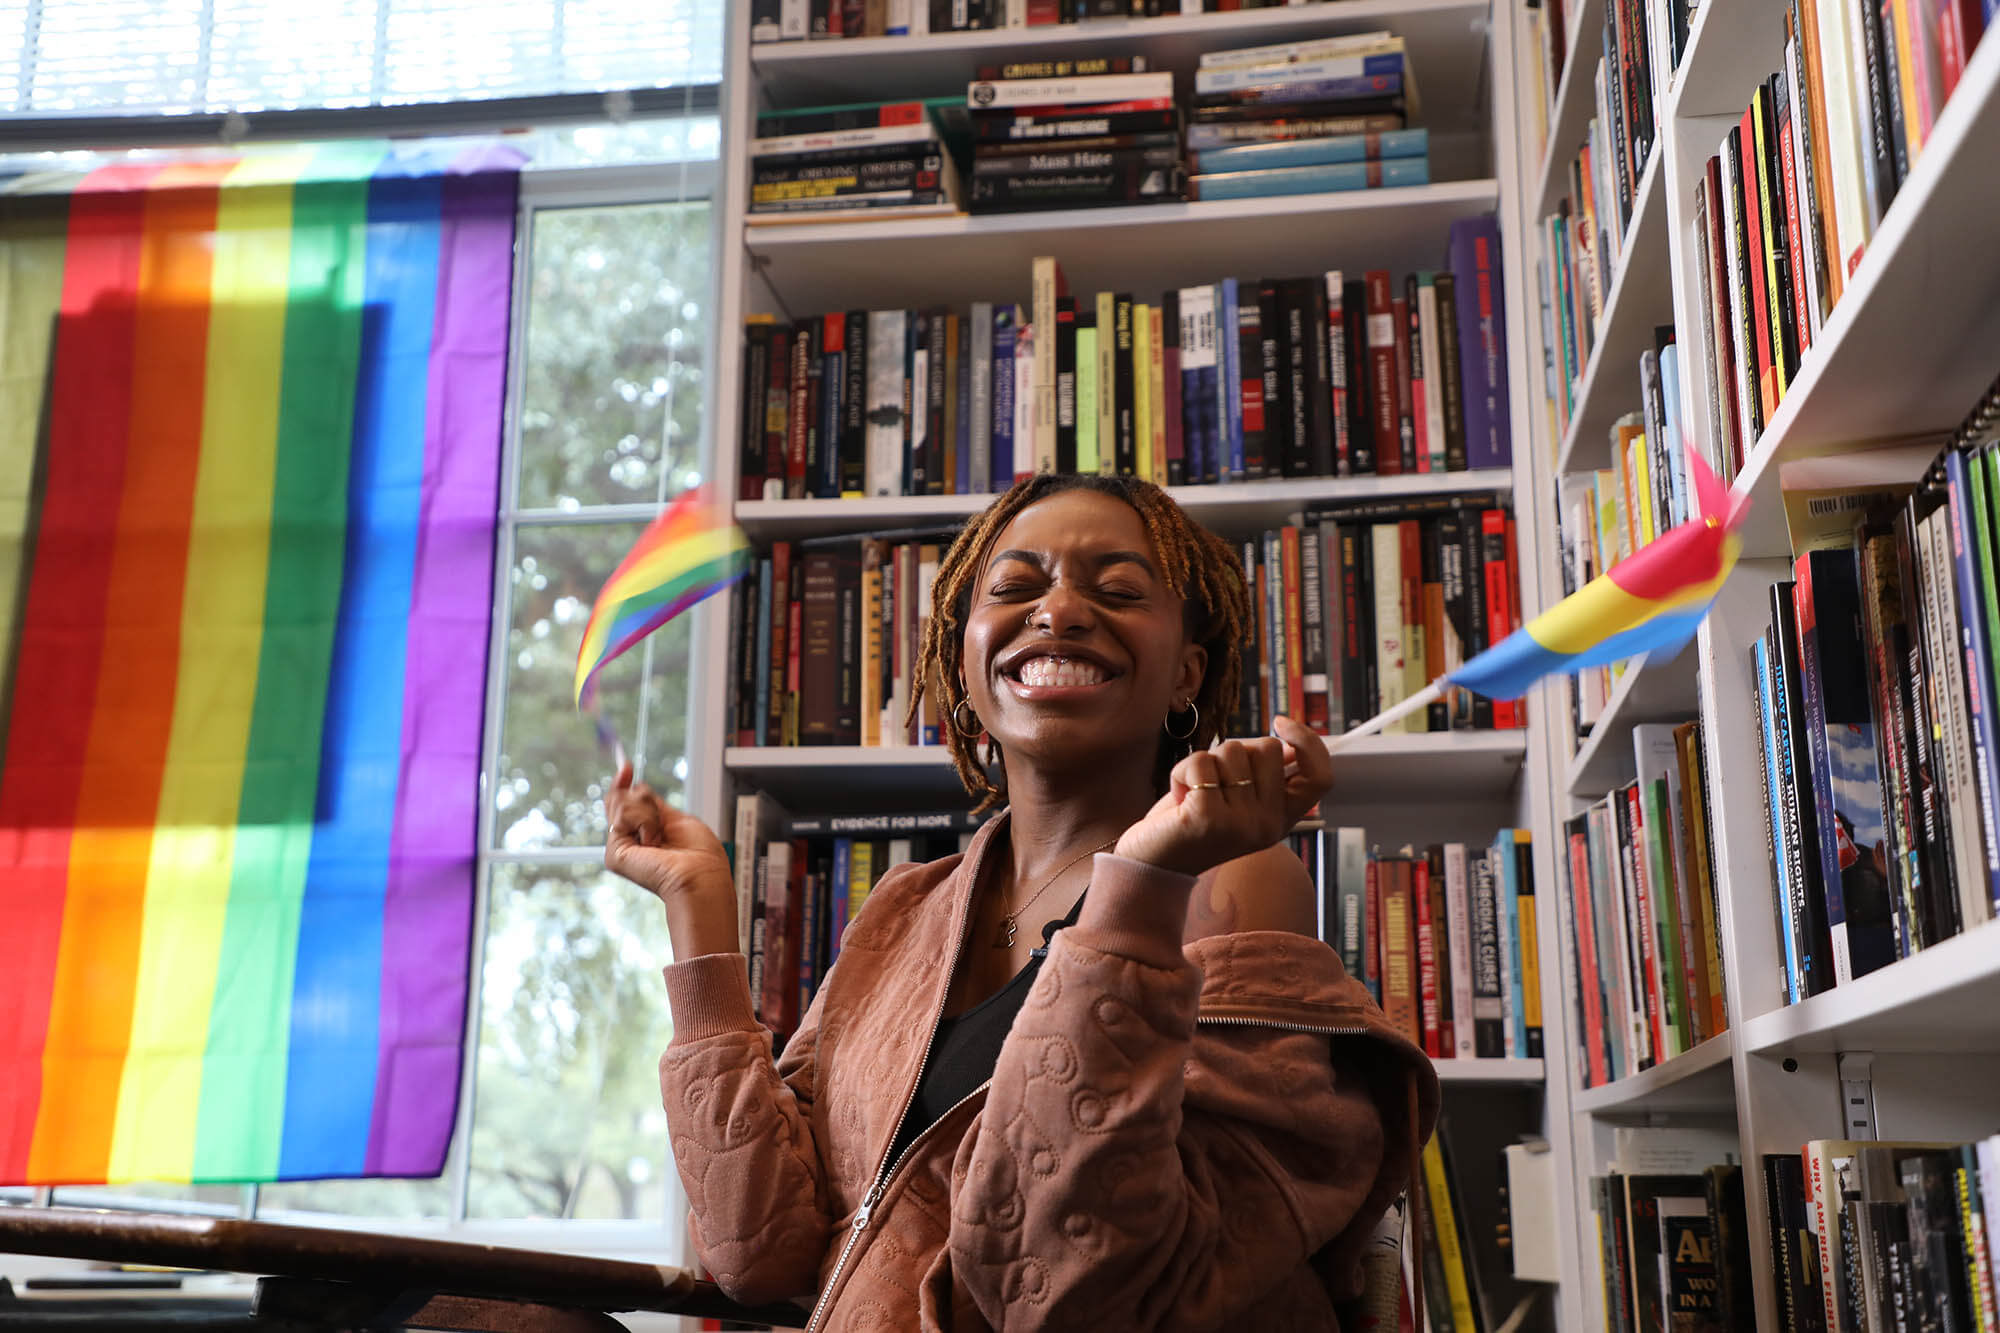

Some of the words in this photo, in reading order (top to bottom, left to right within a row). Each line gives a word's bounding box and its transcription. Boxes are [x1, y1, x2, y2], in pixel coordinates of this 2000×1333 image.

[1029, 154, 1069, 169] Mass
[1782, 128, 1793, 168] World
[1786, 170, 1798, 219] Poverty
[1790, 222, 1800, 245] and
[1792, 248, 1805, 295] Human
[1797, 297, 1809, 342] Rights
[1909, 646, 1919, 672] The
[1752, 690, 1761, 724] RACE
[1774, 664, 1787, 713] JIMMY
[1911, 673, 1929, 763] Phenomenon
[1774, 728, 1787, 801] SOCIOLOGY
[1779, 718, 1793, 781] CARTER.
[1804, 643, 1818, 702] HUMAN
[1811, 705, 1824, 762] RIGHTS
[1818, 765, 1828, 804] POLITICS
[1825, 829, 1835, 873] PRACTICE
[1758, 751, 1769, 803] HUMAN
[831, 816, 888, 829] EVIDENCE
[891, 815, 915, 827] FOR
[917, 814, 951, 826] HOPE
[1763, 806, 1774, 861] RIGHTS
[1781, 804, 1790, 834] AND
[1786, 782, 1799, 845] HUMAN
[1922, 784, 1937, 842] Torture
[1785, 837, 1794, 883] HUMAN
[1792, 850, 1805, 912] RIGHTS.
[1476, 857, 1495, 945] CAMBODIA'S
[1789, 886, 1799, 932] RIGHTS
[1419, 924, 1433, 962] NEVER
[1421, 964, 1435, 994] FALL
[1481, 944, 1498, 994] CURSE
[1423, 998, 1437, 1031] DOWN
[1811, 1157, 1821, 1193] WHY
[1815, 1199, 1829, 1274] AMERICA
[1888, 1242, 1901, 1285] THE
